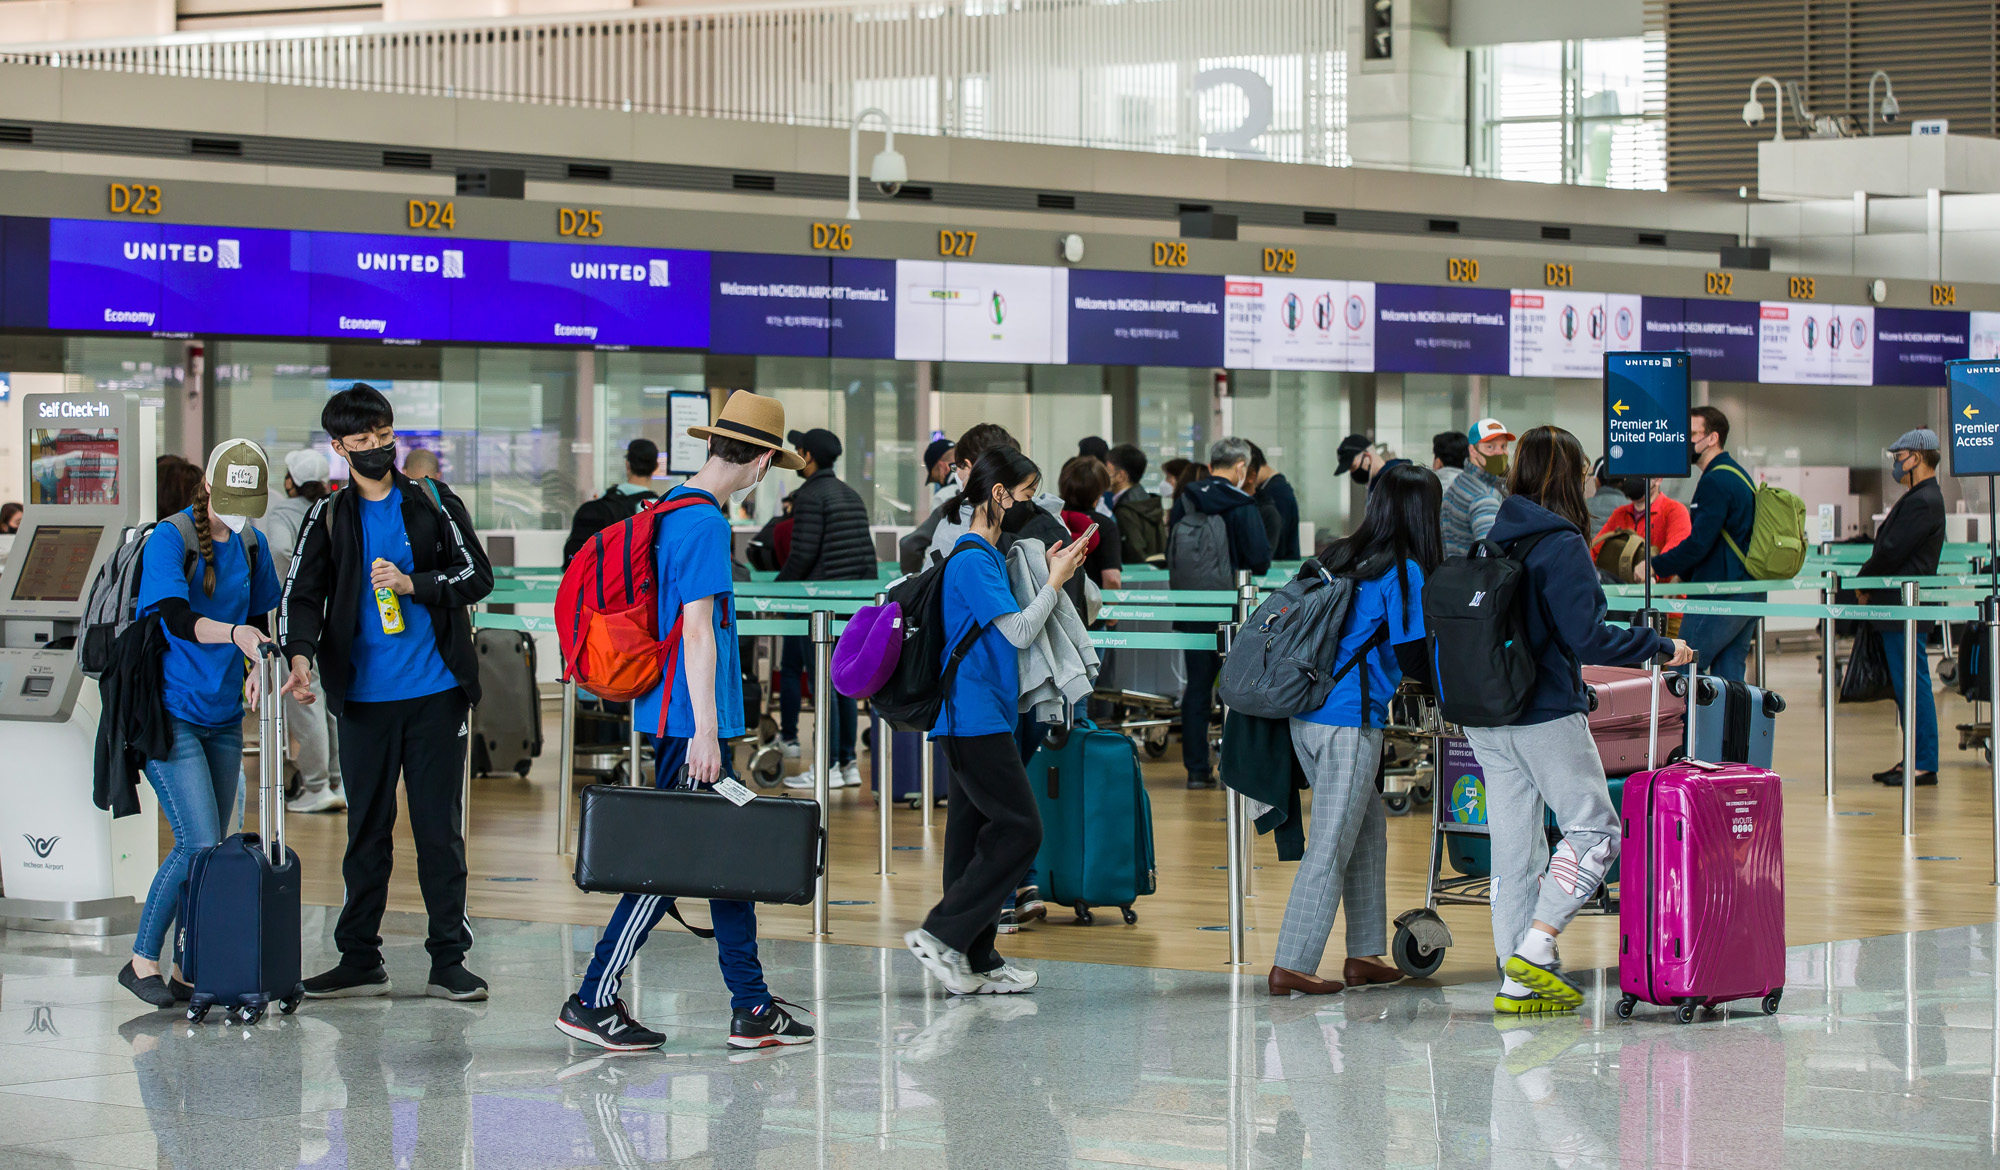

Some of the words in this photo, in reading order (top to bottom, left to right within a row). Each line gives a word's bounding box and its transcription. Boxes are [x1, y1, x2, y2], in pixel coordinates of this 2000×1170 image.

[110, 183, 162, 214] D23
[409, 201, 456, 230] D24
[559, 209, 603, 237] D25
[812, 223, 853, 250] D26
[940, 230, 978, 256] D27
[124, 243, 213, 264] UNITED
[358, 252, 440, 272] UNITED
[1154, 242, 1189, 266] D28
[1263, 249, 1296, 273] D29
[570, 263, 646, 282] UNITED
[1448, 258, 1479, 282] D30
[1546, 263, 1573, 286] D31
[720, 282, 758, 296] Welcome
[759, 284, 768, 296] to
[769, 284, 807, 298] INCHEON
[808, 286, 844, 300] AIRPORT
[845, 287, 880, 300] Terminal
[1706, 272, 1733, 294] D32
[1790, 277, 1815, 298] D33
[1932, 285, 1956, 305] D34
[1075, 297, 1107, 310] Welcome
[1108, 299, 1116, 310] to
[1117, 299, 1150, 312] INCHEON
[1150, 300, 1180, 312] AIRPORT
[1181, 302, 1210, 314] Terminal
[104, 308, 155, 327] Economy
[339, 316, 386, 334] Economy
[1381, 310, 1409, 321] Welcome
[1410, 311, 1416, 322] to
[1417, 311, 1445, 323] INCHEON
[1446, 312, 1471, 324] AIRPORT
[1472, 312, 1498, 325] Terminal
[554, 323, 598, 340] Economy
[39, 402, 60, 418] Self
[61, 401, 110, 418] Check-In
[1610, 418, 1652, 430] Premier
[1655, 418, 1668, 430] 1K
[1955, 422, 2000, 434] Premier
[1610, 431, 1648, 442] United
[1649, 431, 1686, 442] Polaris
[1956, 436, 1994, 446] Access
[1105, 637, 1127, 646] Airport
